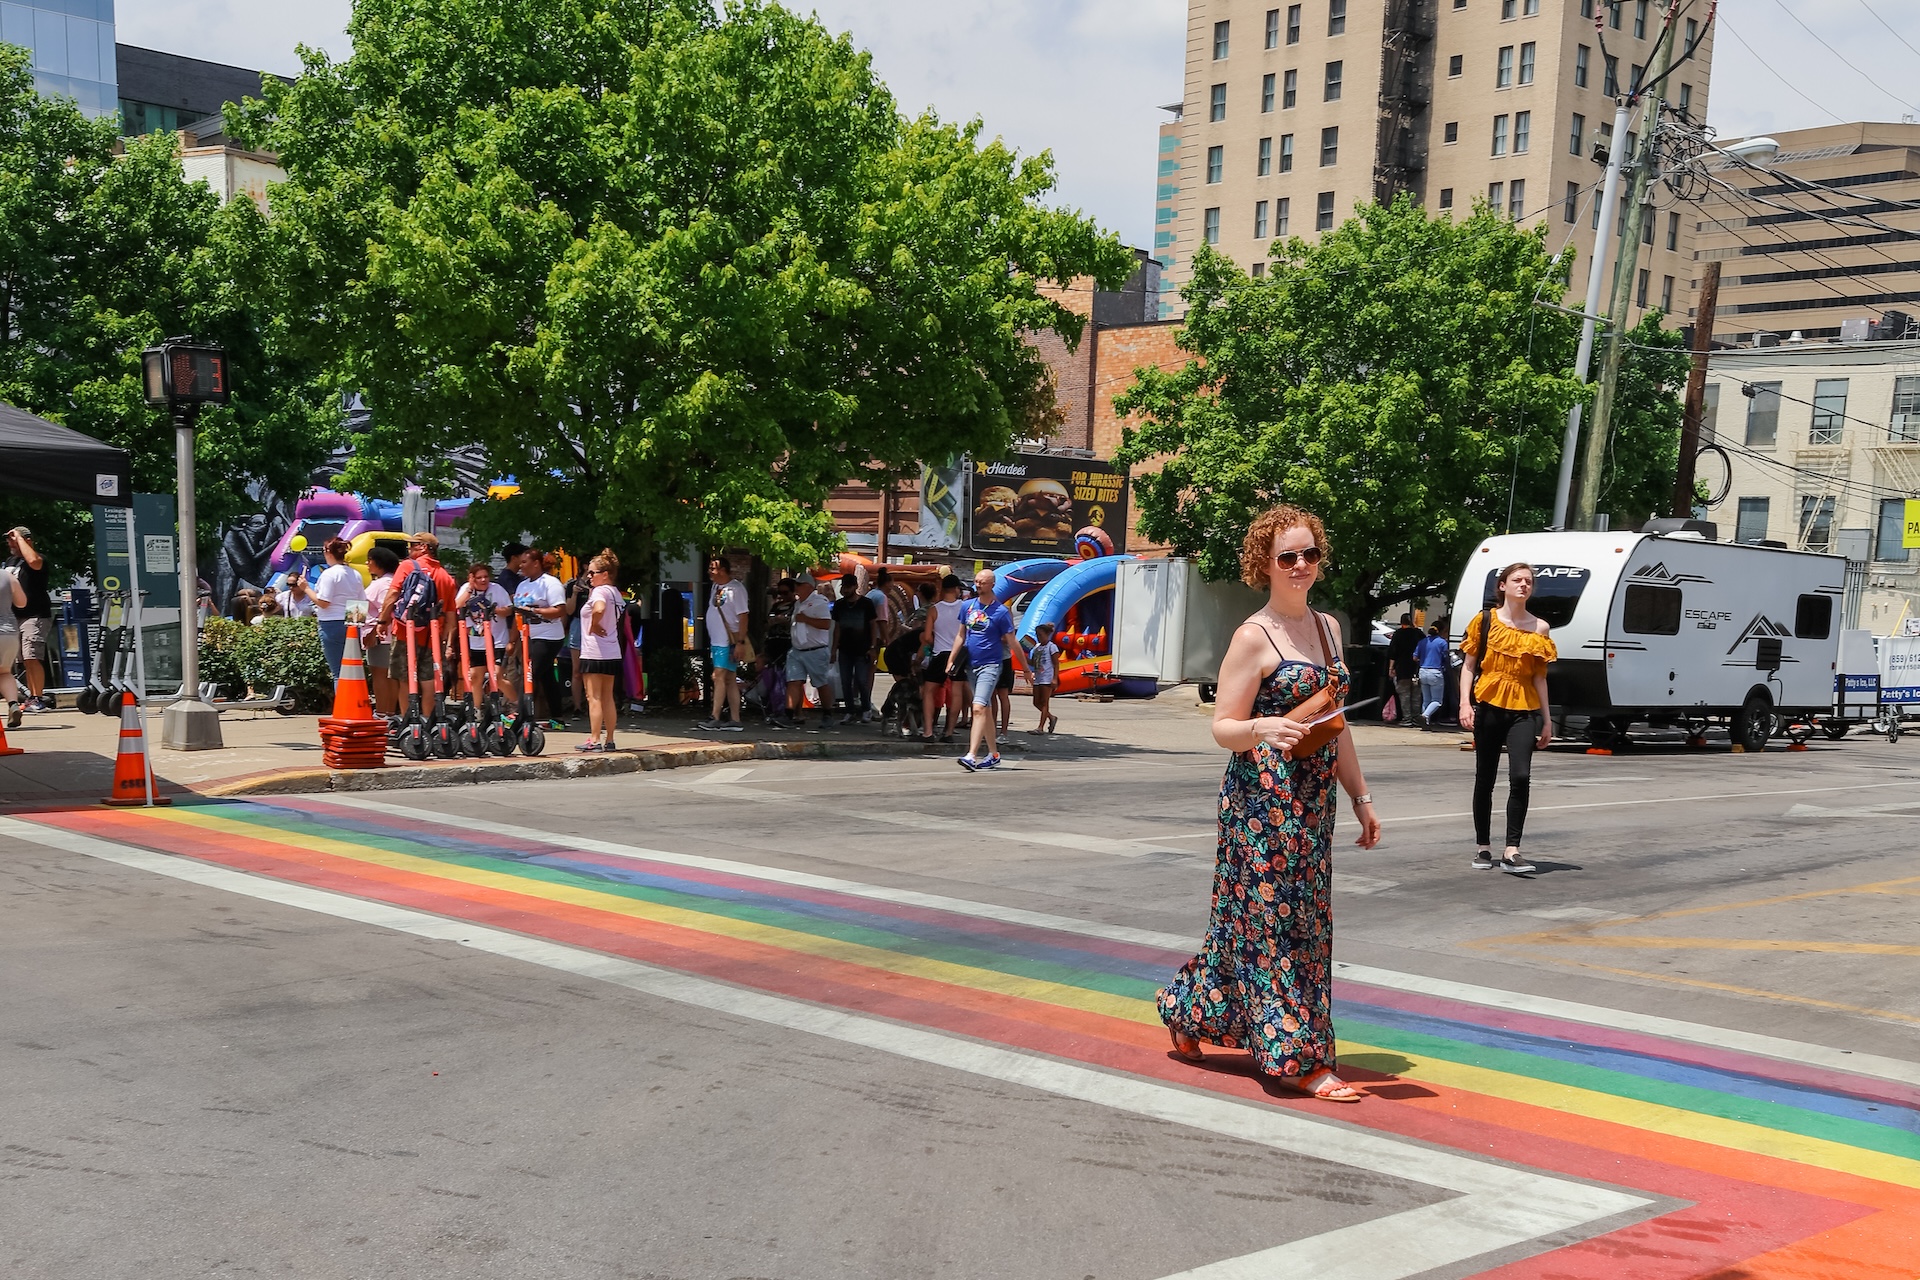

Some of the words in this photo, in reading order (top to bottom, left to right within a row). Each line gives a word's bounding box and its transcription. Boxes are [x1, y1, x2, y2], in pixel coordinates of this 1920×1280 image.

[210, 357, 223, 393] 3
[986, 462, 1026, 476] Hardee's
[1070, 471, 1085, 486] FOR
[1088, 472, 1125, 489] JURASSIC
[1073, 486, 1095, 502] SIZED
[1097, 487, 1119, 504] BITES
[1685, 609, 1733, 621] ESCAPE
[1881, 690, 1910, 700] Patty's
